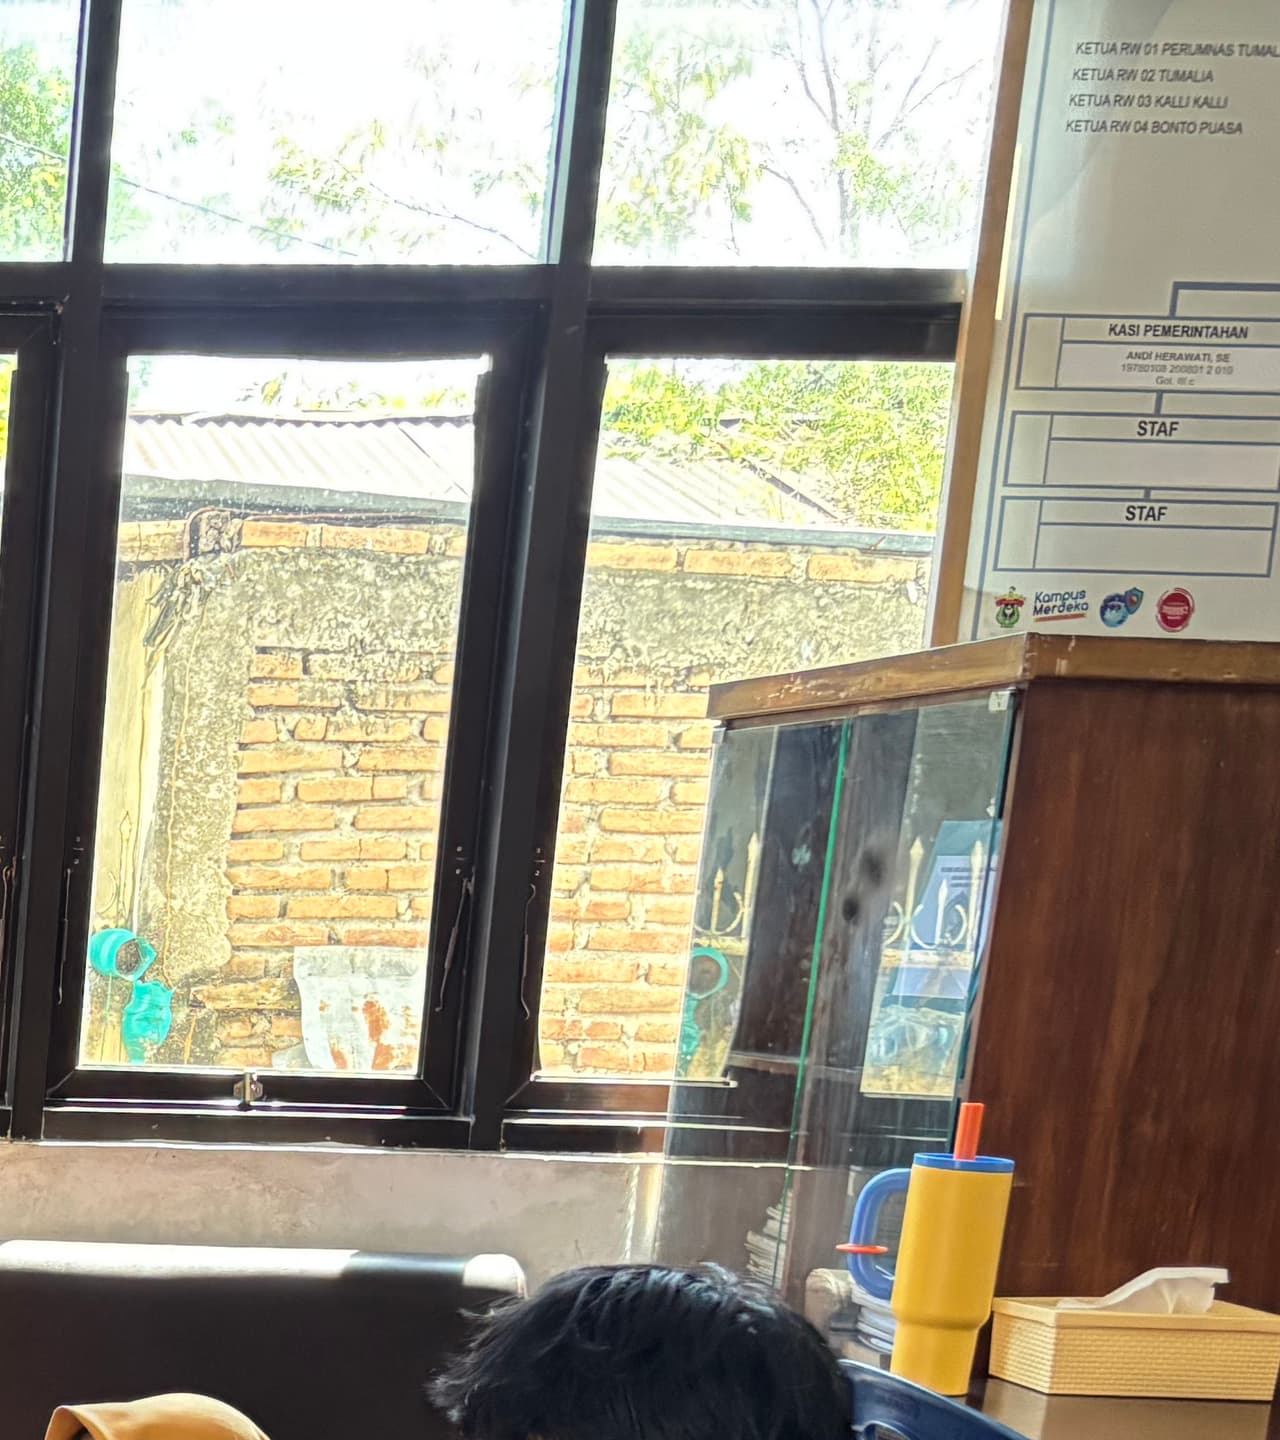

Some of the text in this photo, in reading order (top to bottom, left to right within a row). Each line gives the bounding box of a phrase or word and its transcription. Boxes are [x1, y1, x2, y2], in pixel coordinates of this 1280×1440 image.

[1076, 42, 1280, 57] KETUA RW 01 PERUMNAS TUMAL
[1072, 68, 1214, 83] KETUA RW 02 TUMALIA
[1068, 94, 1114, 107] KETUA
[1114, 94, 1135, 107] RW
[1137, 95, 1152, 108] 03
[1065, 119, 1243, 135] KETUA RW 04 BONTO PUASA
[1108, 323, 1249, 339] KASI PEMERINTAHAN
[1126, 351, 1153, 361] ANDI
[1216, 353, 1231, 363] SE
[1137, 420, 1179, 437] STAF
[1125, 505, 1168, 521] STAF
[1034, 590, 1087, 605] Kampus
[1033, 601, 1089, 616] Merdeka
